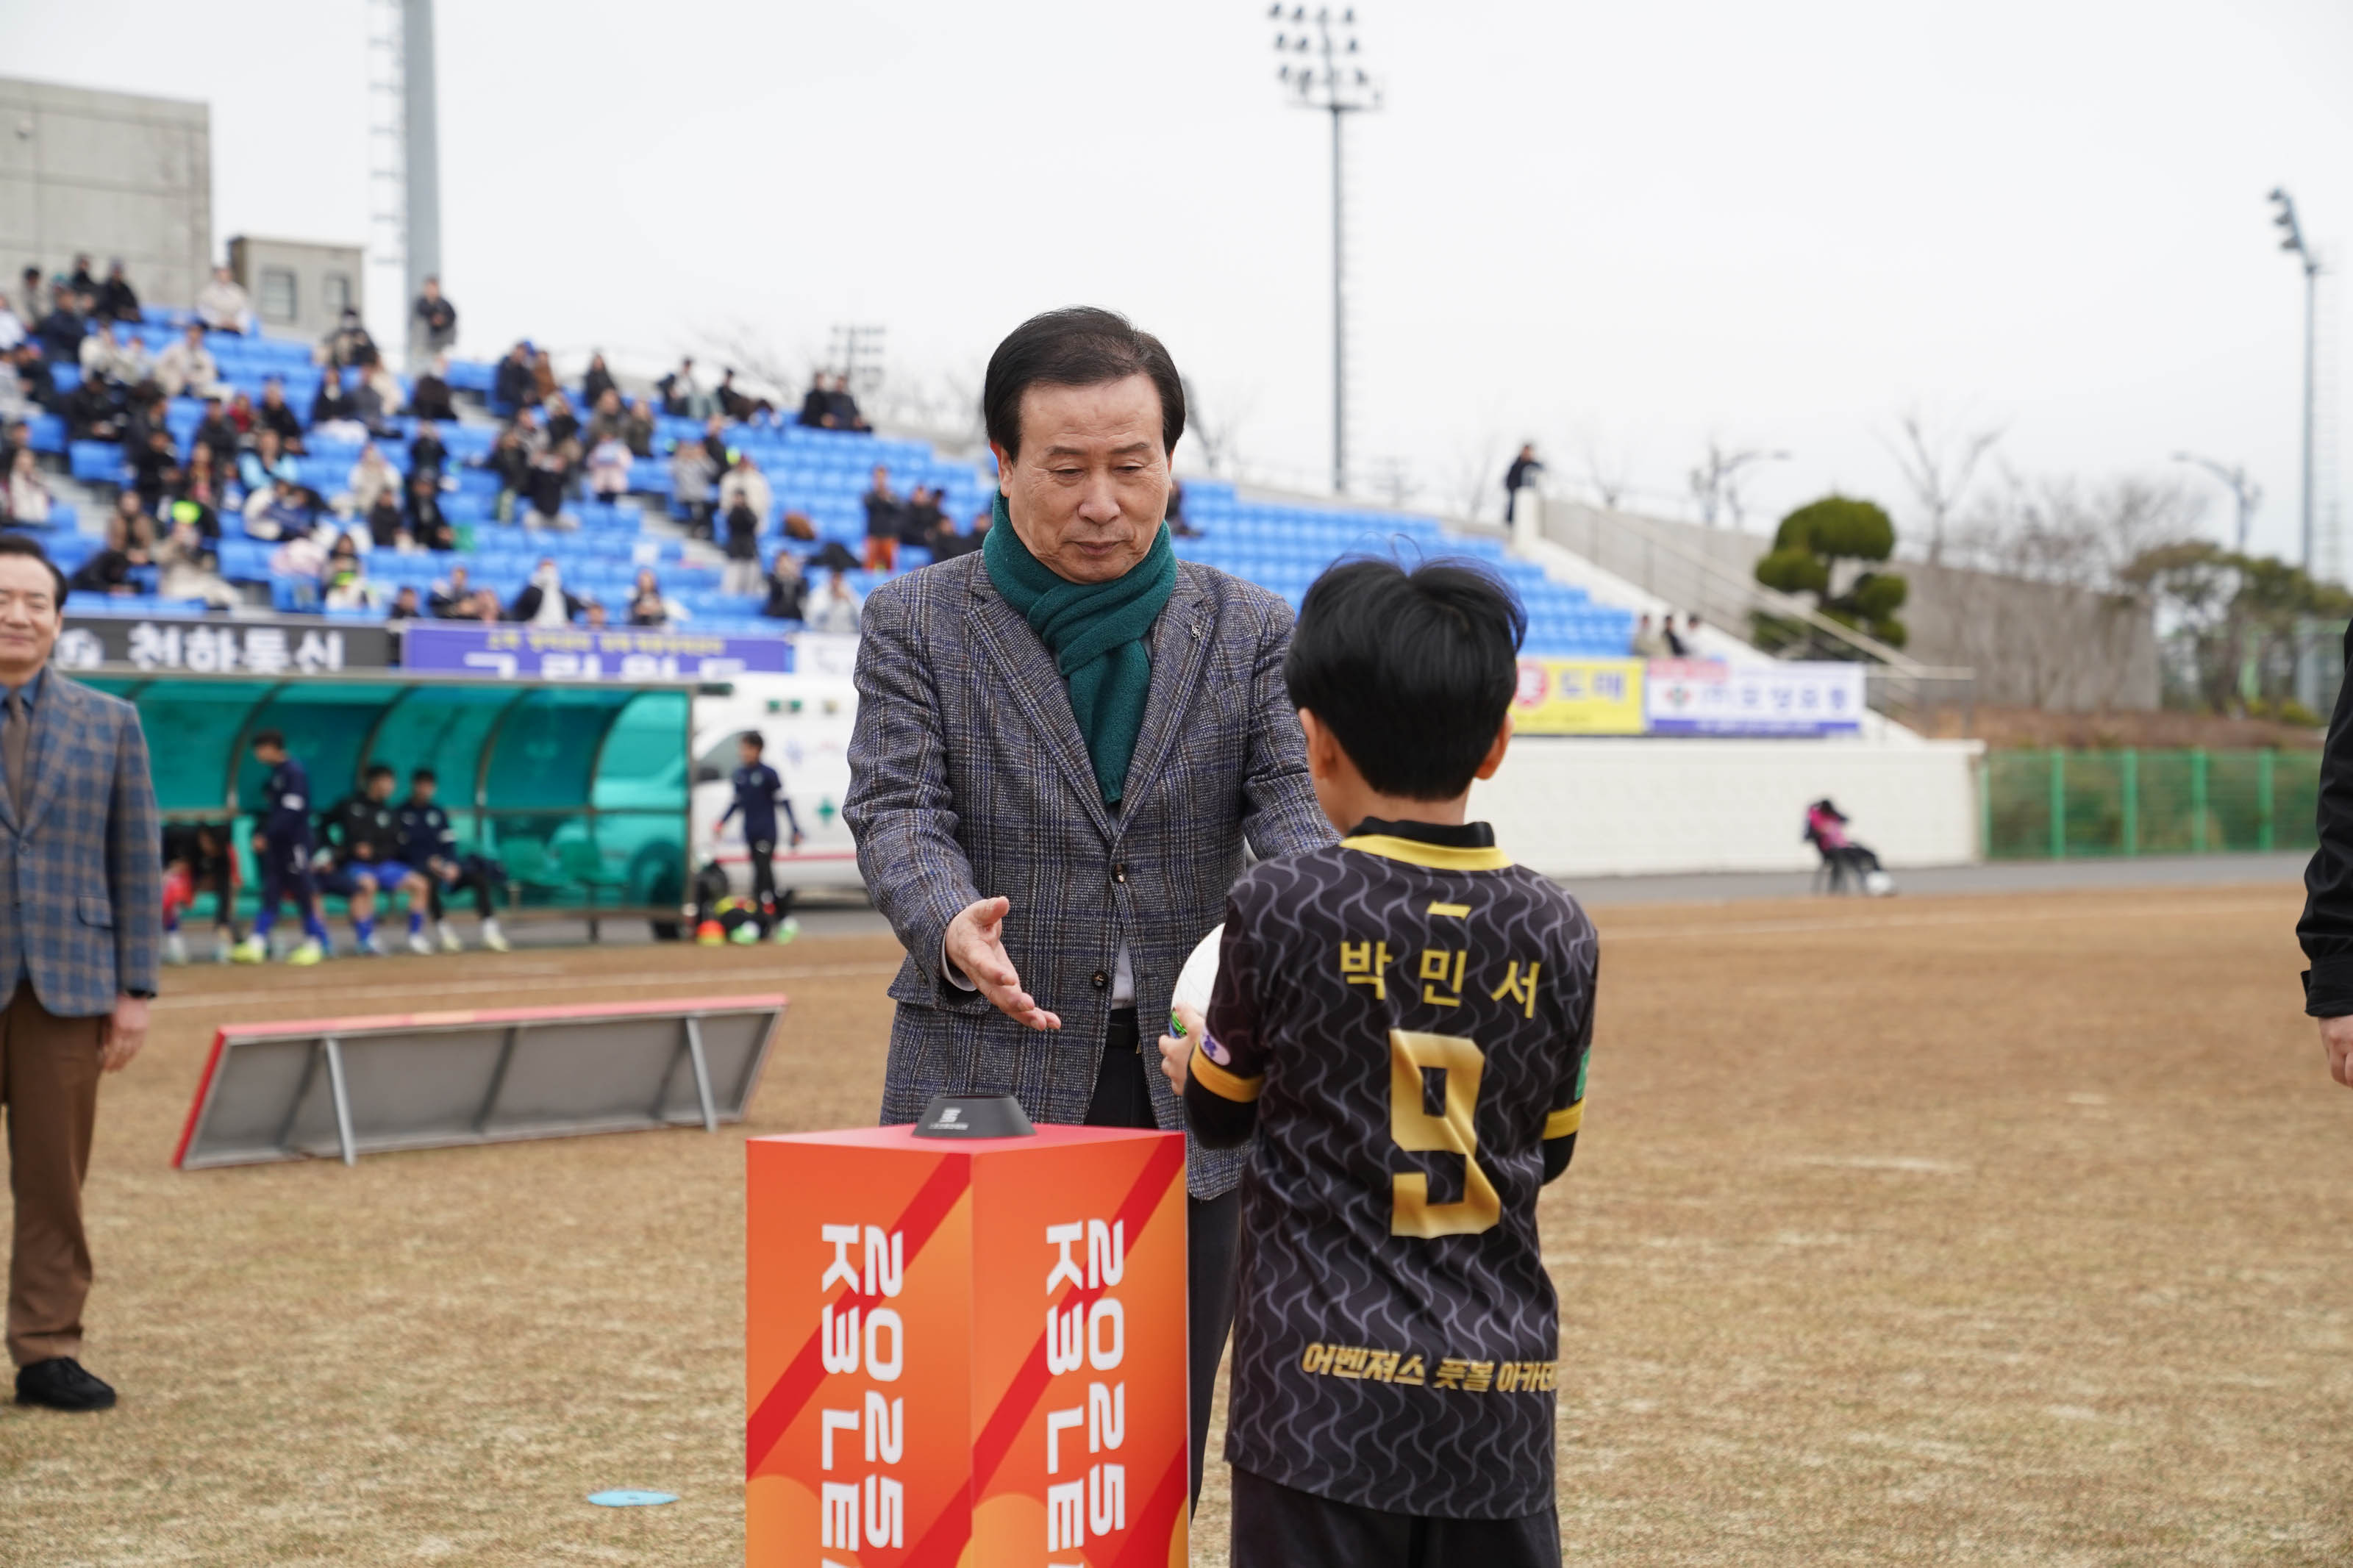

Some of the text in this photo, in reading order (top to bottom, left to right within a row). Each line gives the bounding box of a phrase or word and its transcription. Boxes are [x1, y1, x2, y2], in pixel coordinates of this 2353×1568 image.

[1389, 1028, 1501, 1239] 9
[821, 1223, 860, 1568] K3 LE
[865, 1224, 904, 1550] 2025
[1046, 1220, 1085, 1568] K3 LE
[1088, 1218, 1126, 1536] 2025
[1301, 1342, 1426, 1386] 어벤져스
[1432, 1357, 1496, 1392] 풋볼
